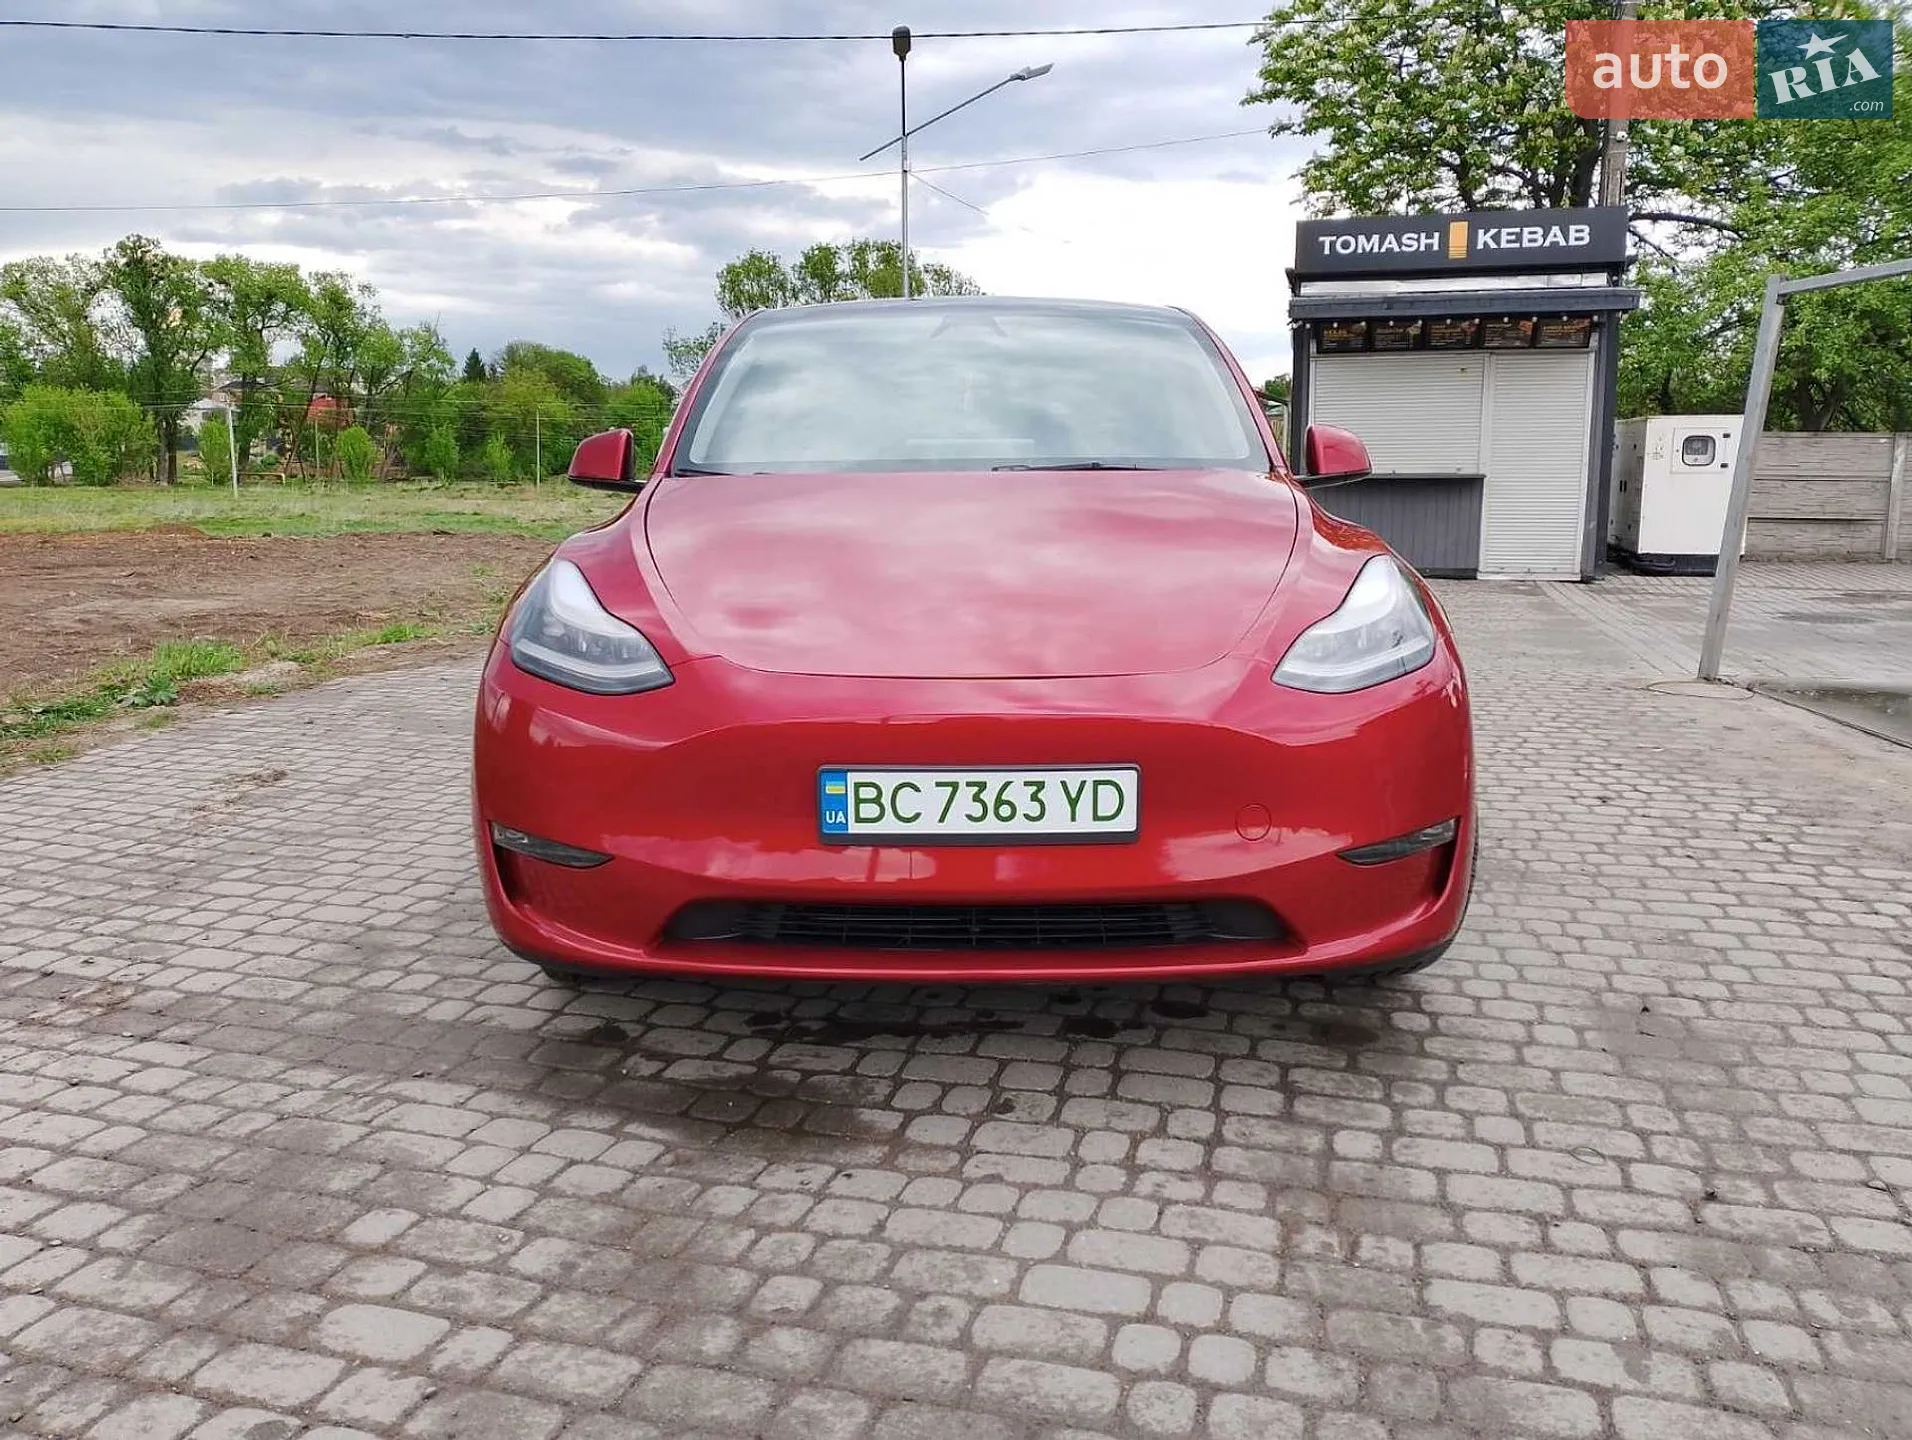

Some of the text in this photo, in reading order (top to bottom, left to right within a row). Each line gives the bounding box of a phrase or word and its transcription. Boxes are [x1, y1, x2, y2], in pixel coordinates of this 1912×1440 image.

[1318, 224, 1591, 256] TOMASH KEBAB
[825, 810, 846, 824] UA
[853, 779, 1125, 825] BC 7363 YD
